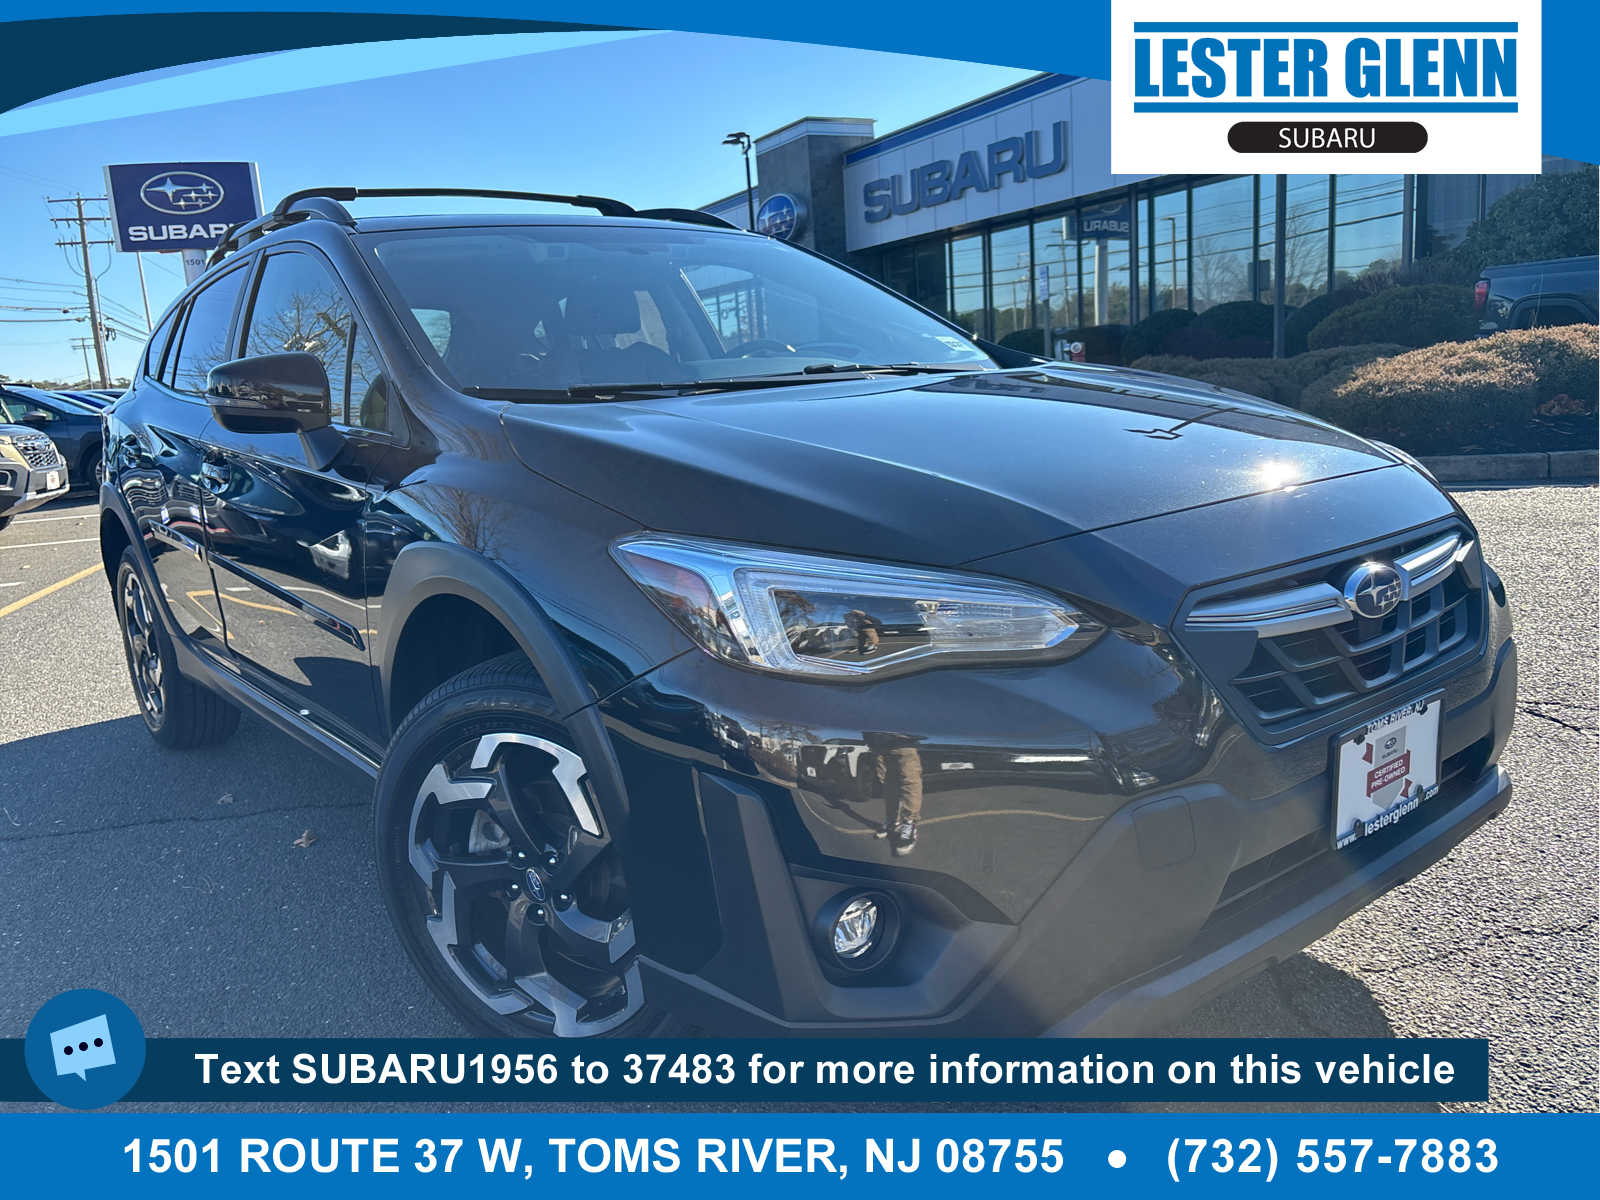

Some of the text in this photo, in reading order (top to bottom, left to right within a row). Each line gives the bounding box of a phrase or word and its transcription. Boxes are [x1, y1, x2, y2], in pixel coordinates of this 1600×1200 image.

[863, 120, 1068, 224] SUBARU
[128, 223, 235, 242] SUBAR
[1370, 766, 1407, 790] PRE-OWNED
[1374, 759, 1404, 779] CERTIFIED
